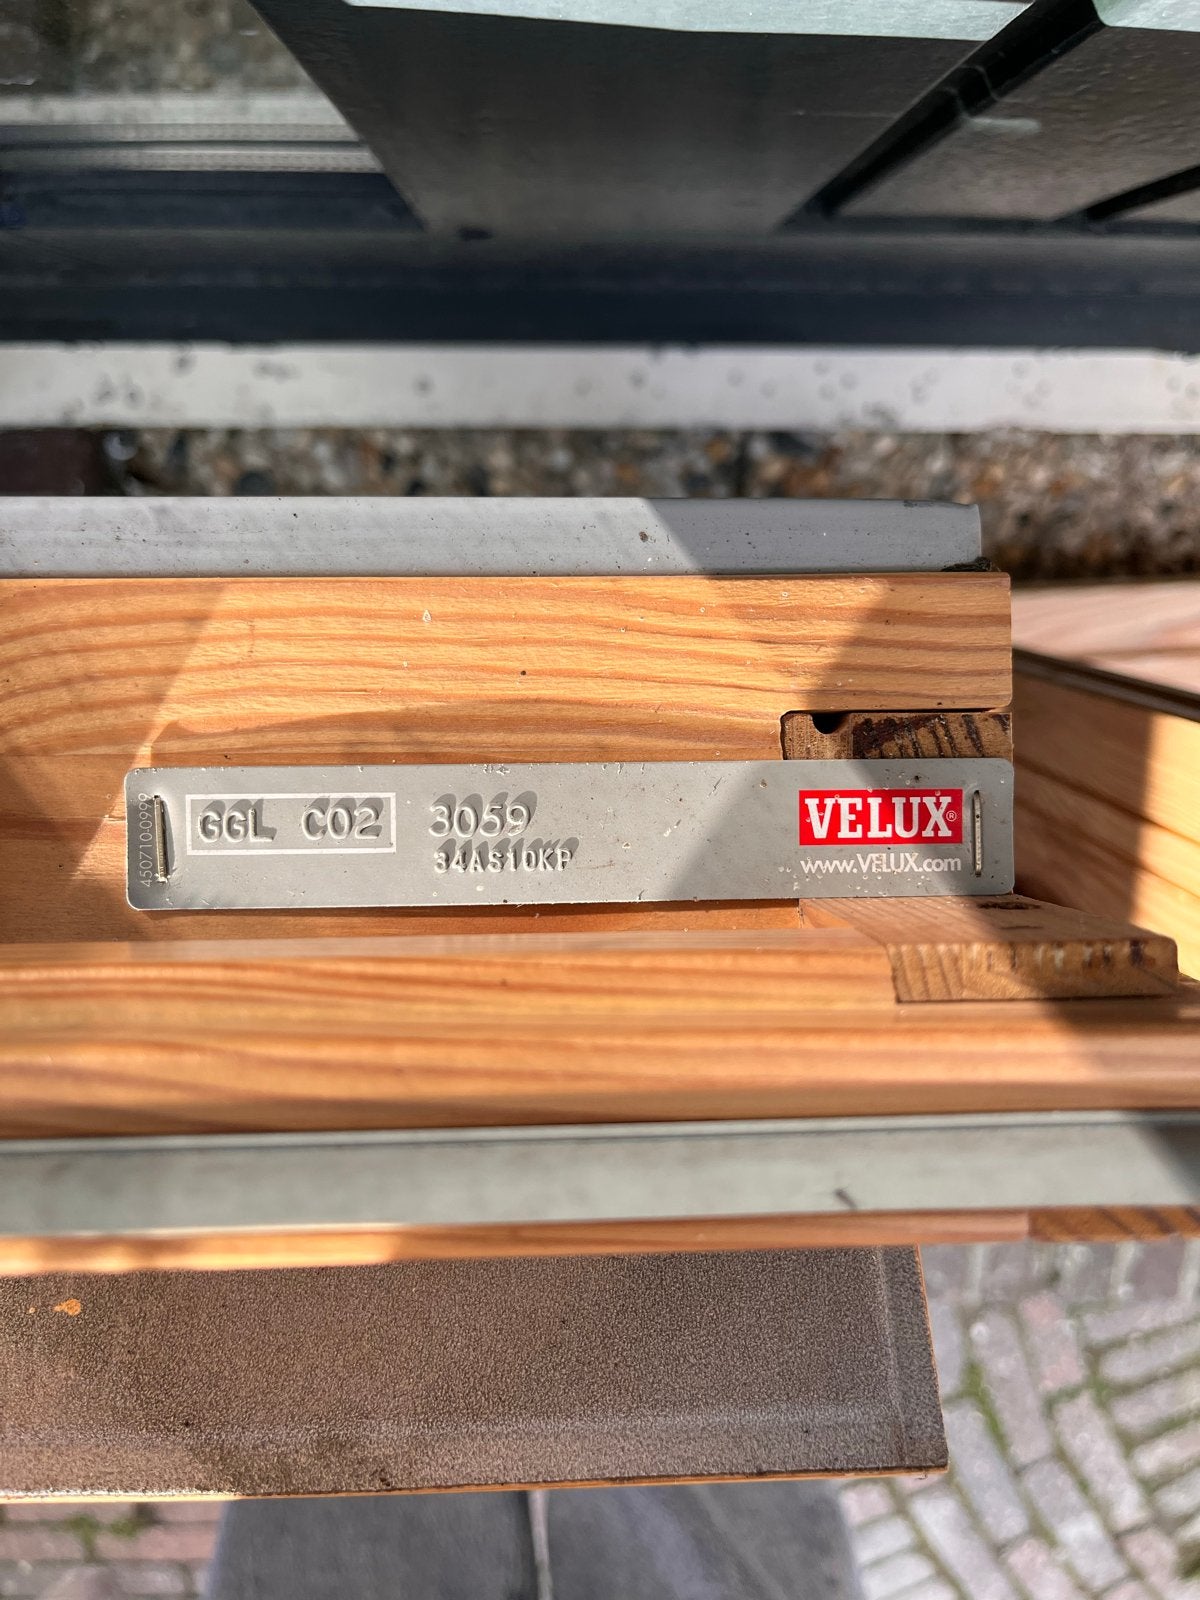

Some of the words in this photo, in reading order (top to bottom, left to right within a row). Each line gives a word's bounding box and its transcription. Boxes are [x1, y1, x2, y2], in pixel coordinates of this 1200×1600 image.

[198, 807, 275, 843] GGL
[428, 803, 531, 837] 3059
[138, 792, 153, 888] 450710-0999
[433, 848, 573, 873] 34AS10KP
[800, 852, 962, 874] www.VELUX.com
